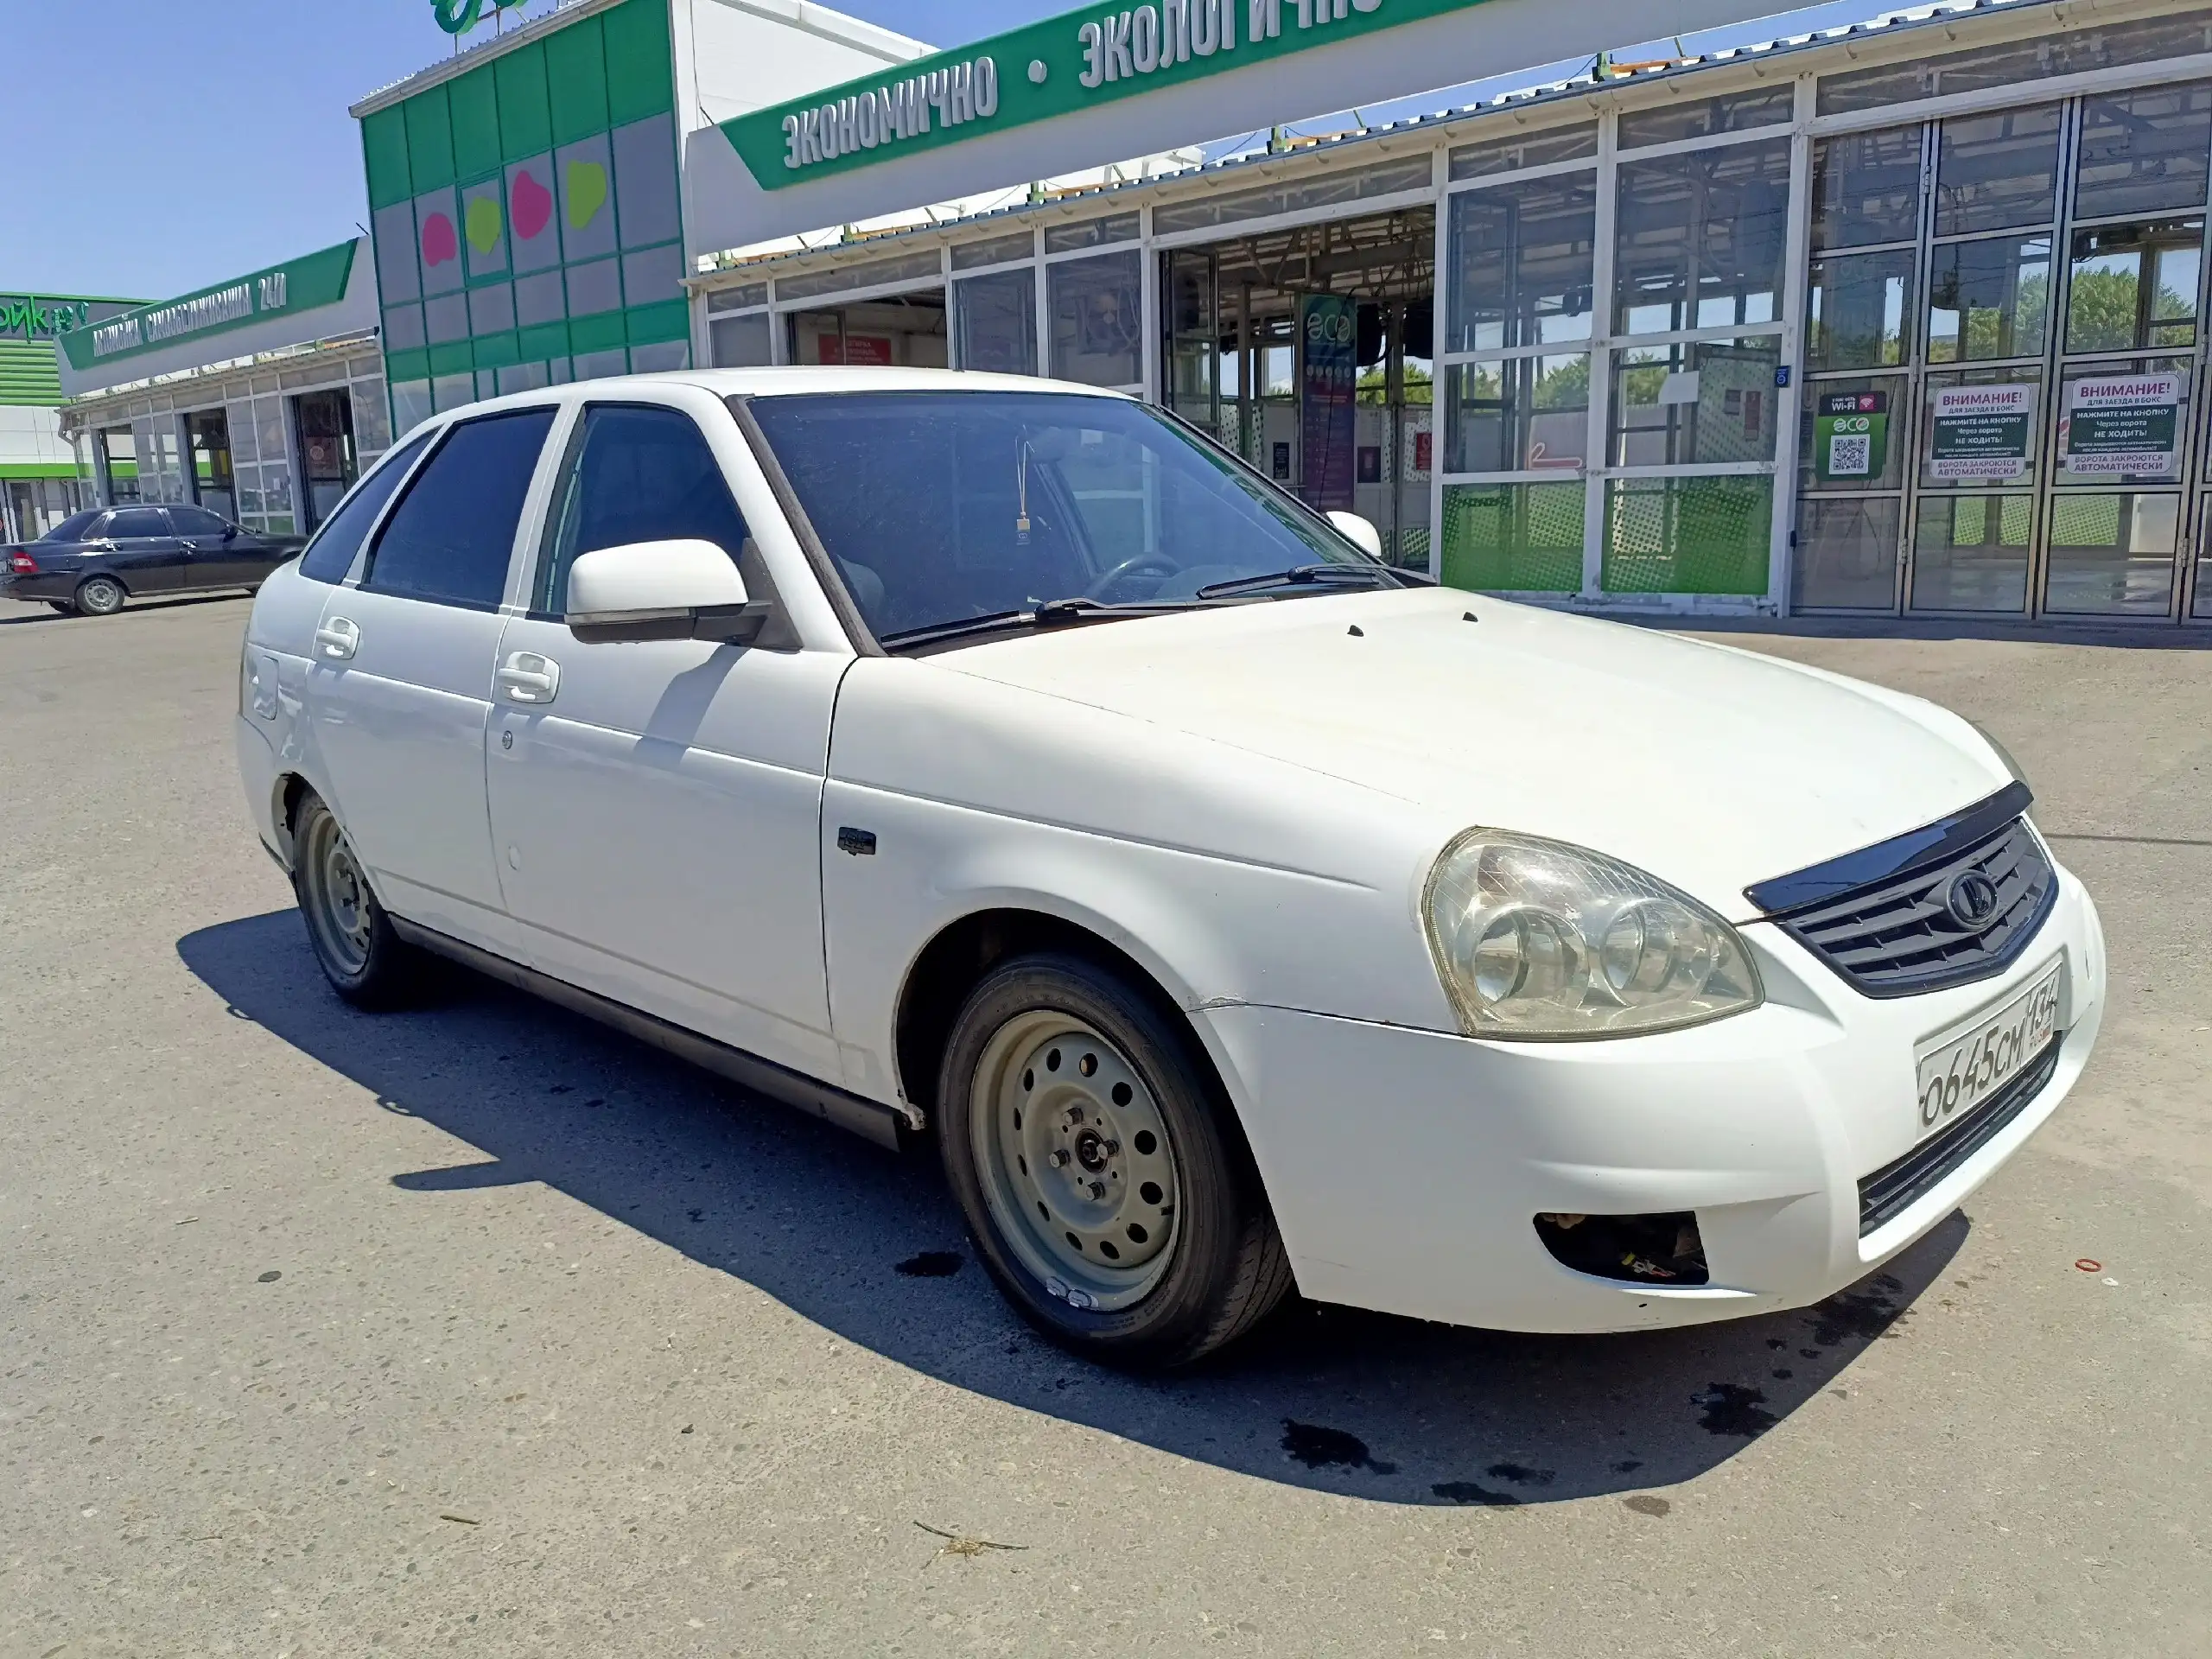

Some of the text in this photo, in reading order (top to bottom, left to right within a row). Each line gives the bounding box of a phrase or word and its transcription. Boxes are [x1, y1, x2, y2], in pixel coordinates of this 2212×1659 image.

[782, 0, 1382, 168] ЭКОНОМИЧНО ЭКОЛОГИ
[2081, 383, 2171, 397] ВНИМАНИЕ!
[1942, 391, 2022, 406] ВНИМАНИЕ!
[1832, 402, 1855, 411] Wi-Fi
[2075, 462, 2163, 472] АВТОМАТИЧЕСКИ
